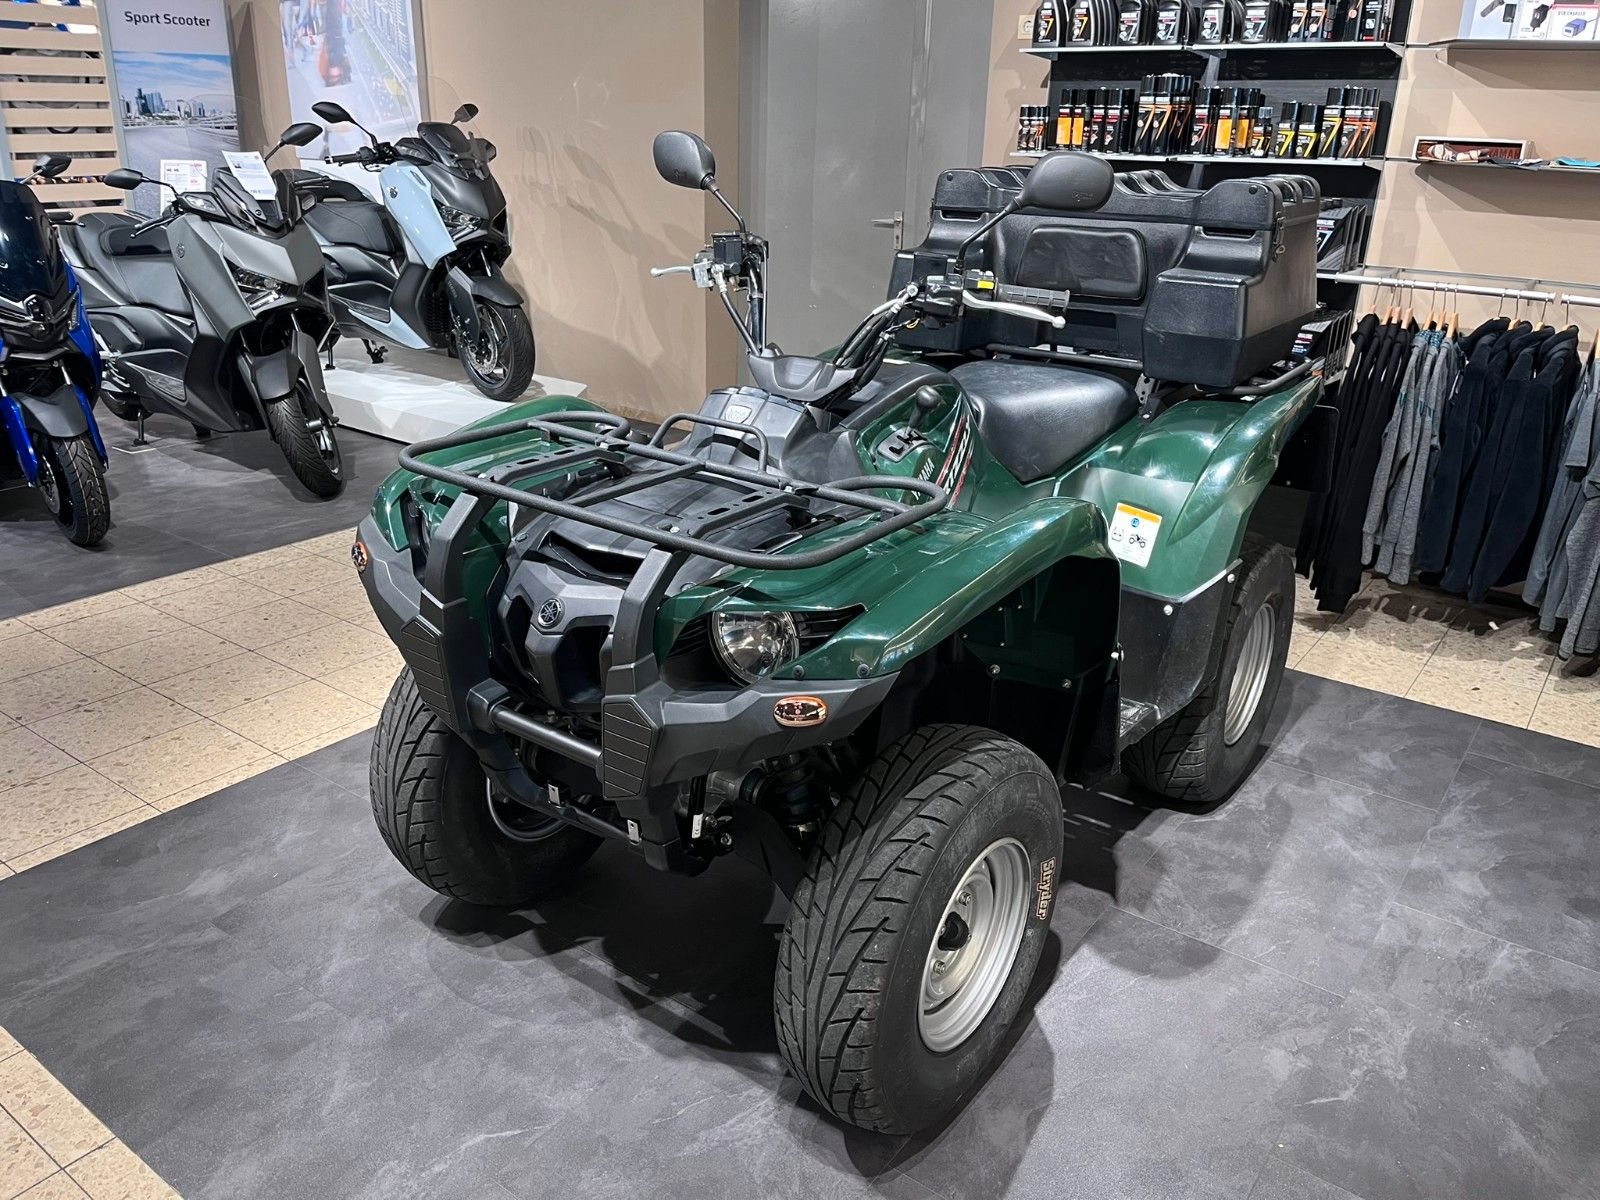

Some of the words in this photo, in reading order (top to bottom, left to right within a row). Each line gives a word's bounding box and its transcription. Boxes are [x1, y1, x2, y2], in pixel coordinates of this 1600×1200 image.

[124, 10, 161, 26] Sport
[163, 13, 211, 27] Scooter
[1037, 858, 1056, 919] Stryder
